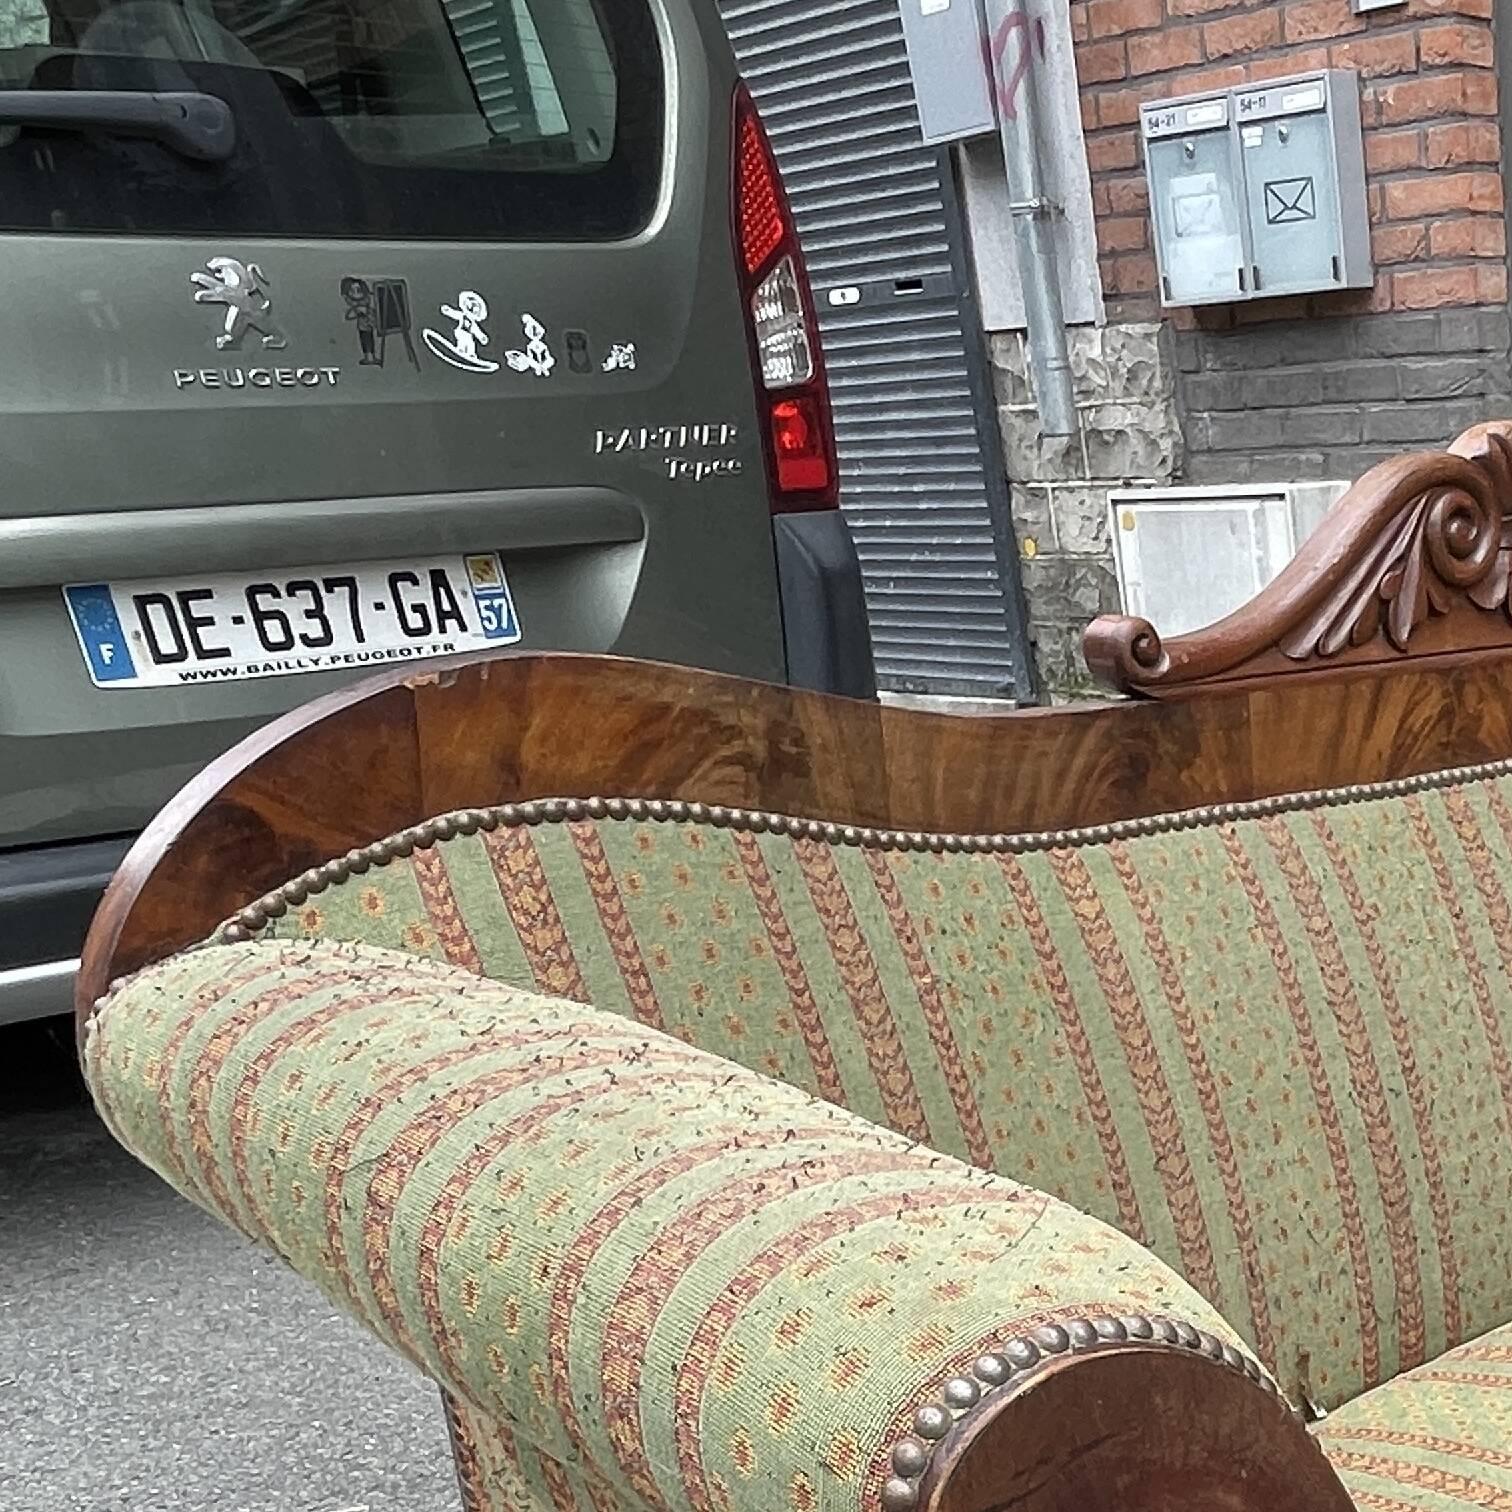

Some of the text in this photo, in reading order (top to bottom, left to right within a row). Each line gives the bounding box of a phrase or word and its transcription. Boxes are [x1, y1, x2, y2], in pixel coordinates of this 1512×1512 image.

[173, 367, 340, 388] PEUGEOT
[594, 424, 739, 453] PARTNER
[132, 569, 468, 665] DE-637-GA
[482, 601, 512, 633] 57
[99, 644, 116, 665] F
